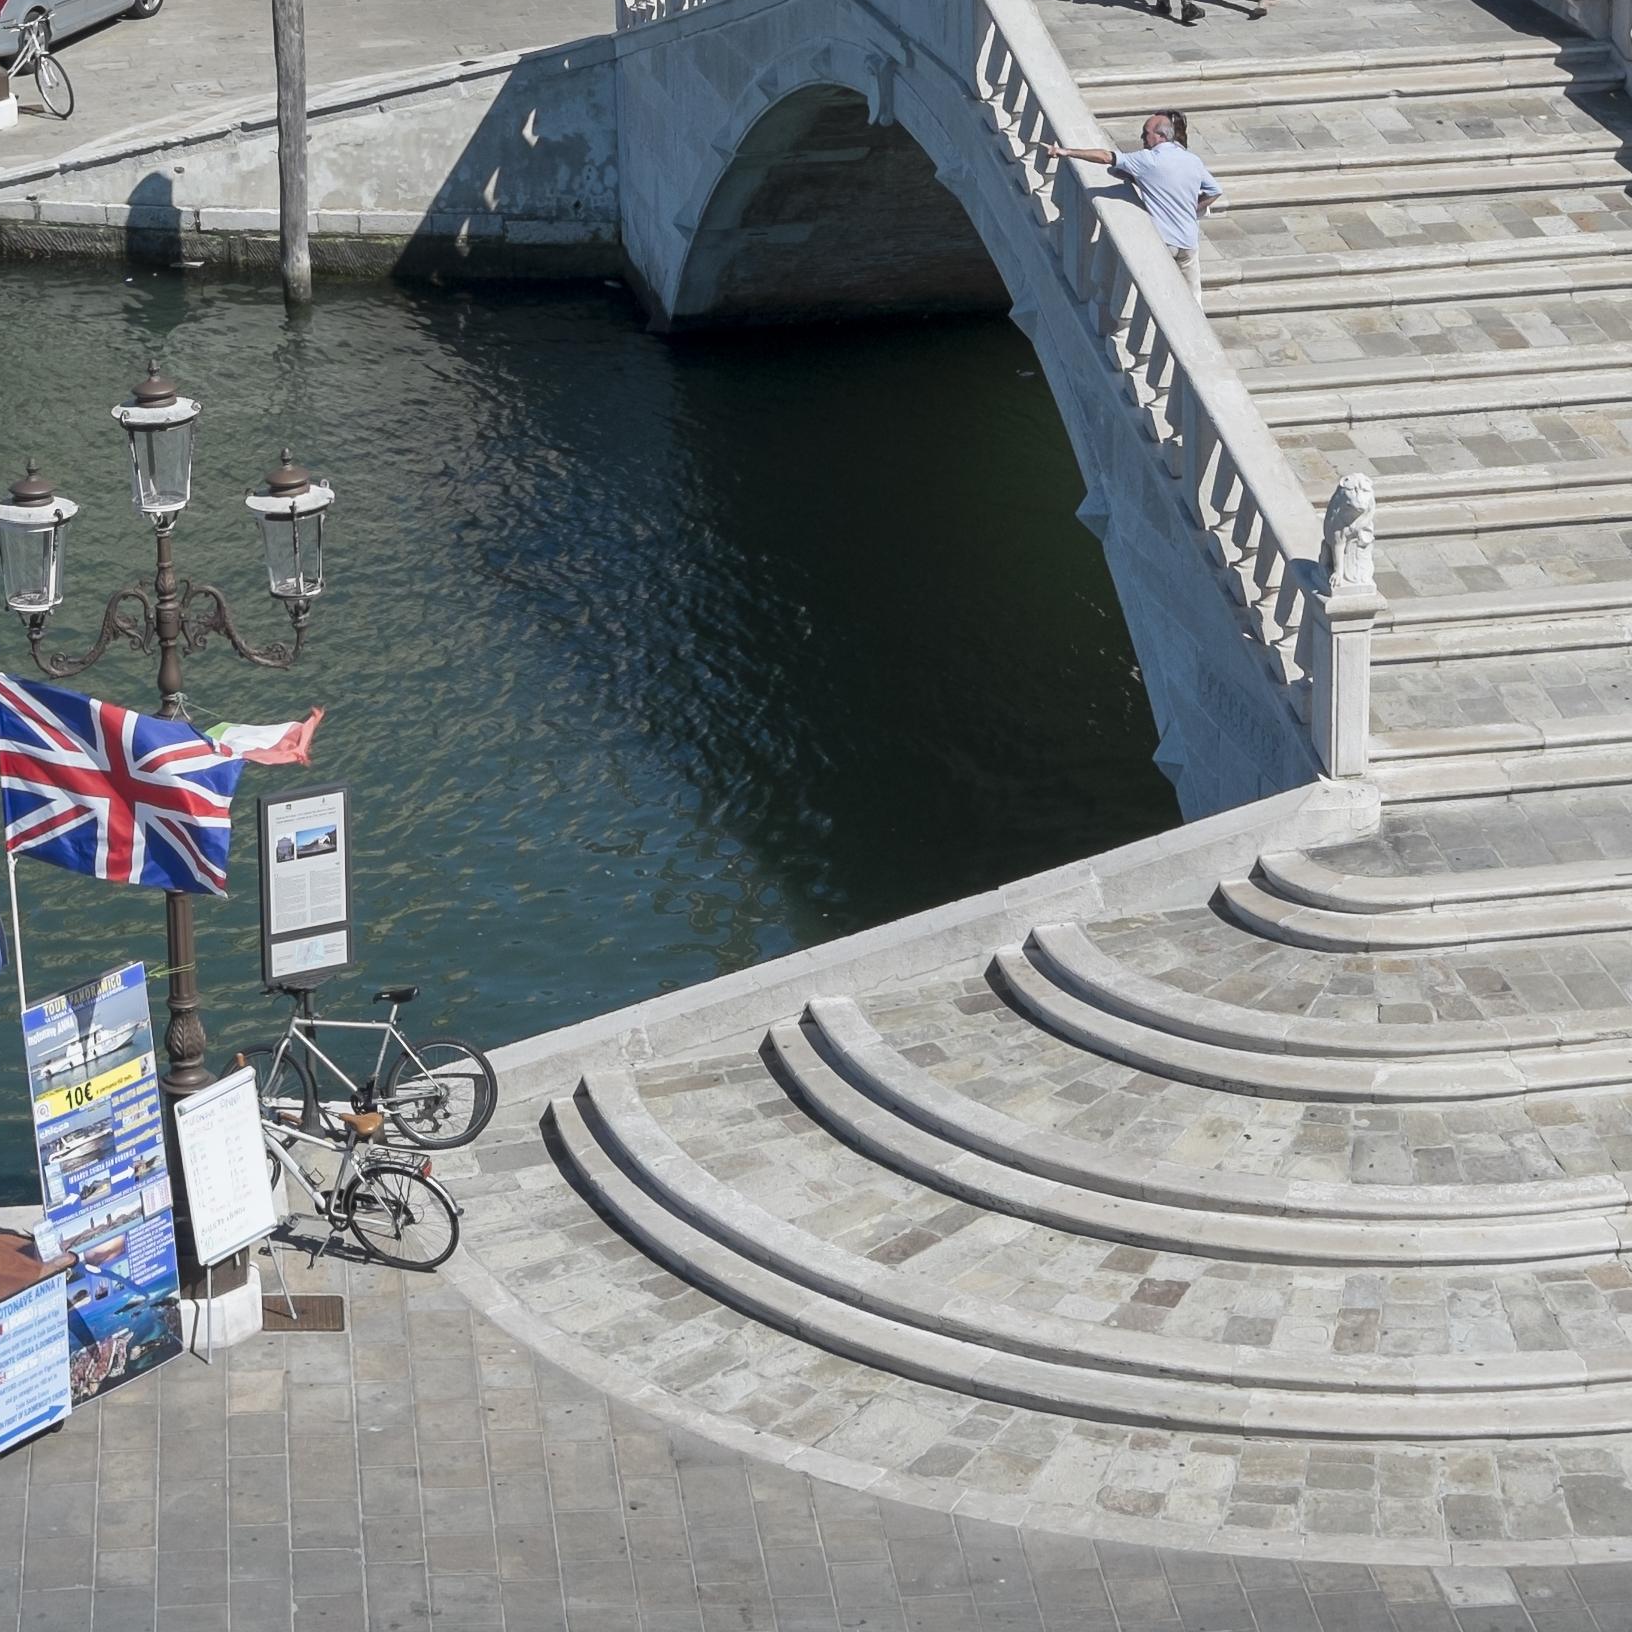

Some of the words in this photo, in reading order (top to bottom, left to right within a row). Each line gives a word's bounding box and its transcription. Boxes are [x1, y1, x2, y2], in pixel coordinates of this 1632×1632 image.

[43, 995, 68, 1018] TOUR
[69, 974, 122, 1007] PANORAMICO
[65, 1081, 94, 1109] 10€
[35, 1280, 56, 1299] ANNA
